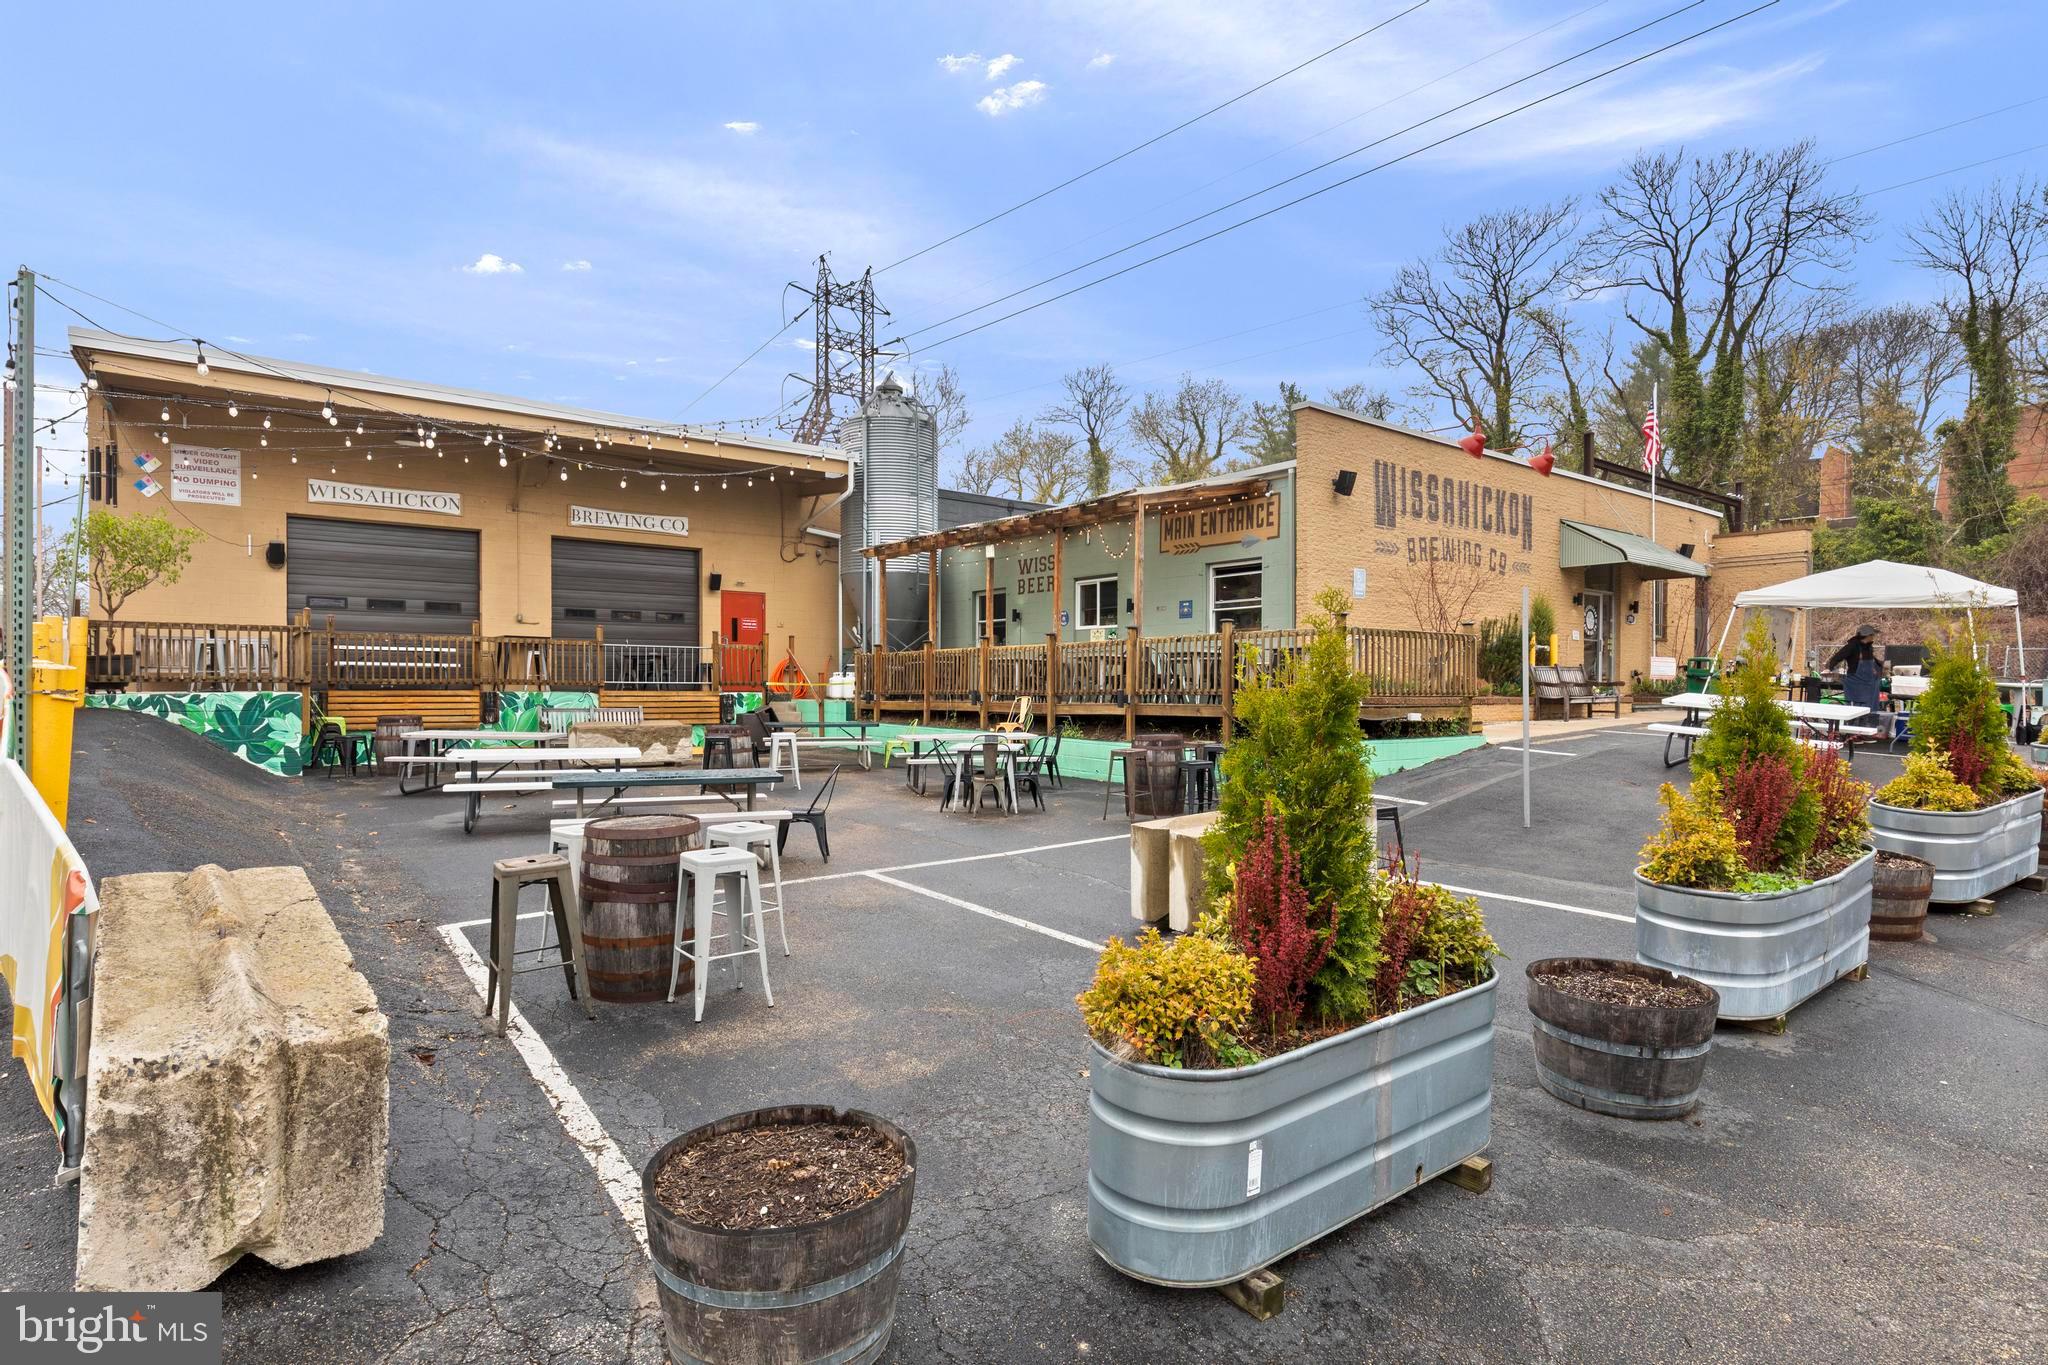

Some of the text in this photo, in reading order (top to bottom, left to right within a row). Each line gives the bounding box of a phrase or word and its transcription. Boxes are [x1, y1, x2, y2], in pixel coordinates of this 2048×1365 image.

[174, 449, 237, 460] UNDER CONSTANT
[193, 458, 220, 466] VIDEO
[174, 463, 238, 476] SURVEILLANCE
[175, 475, 237, 488] NO DUMPING
[178, 488, 211, 496] VIOLATORS
[187, 494, 226, 502] PROSECUTED
[309, 483, 460, 512] WISSAHICKON
[1374, 459, 1533, 551] WISSAHICKON
[572, 508, 655, 529] BREWING
[1164, 501, 1275, 541] MAIN ENTRANCE
[1017, 554, 1056, 575] WISS
[1407, 536, 1507, 576] BREWING CO
[1017, 575, 1055, 595] BEER
